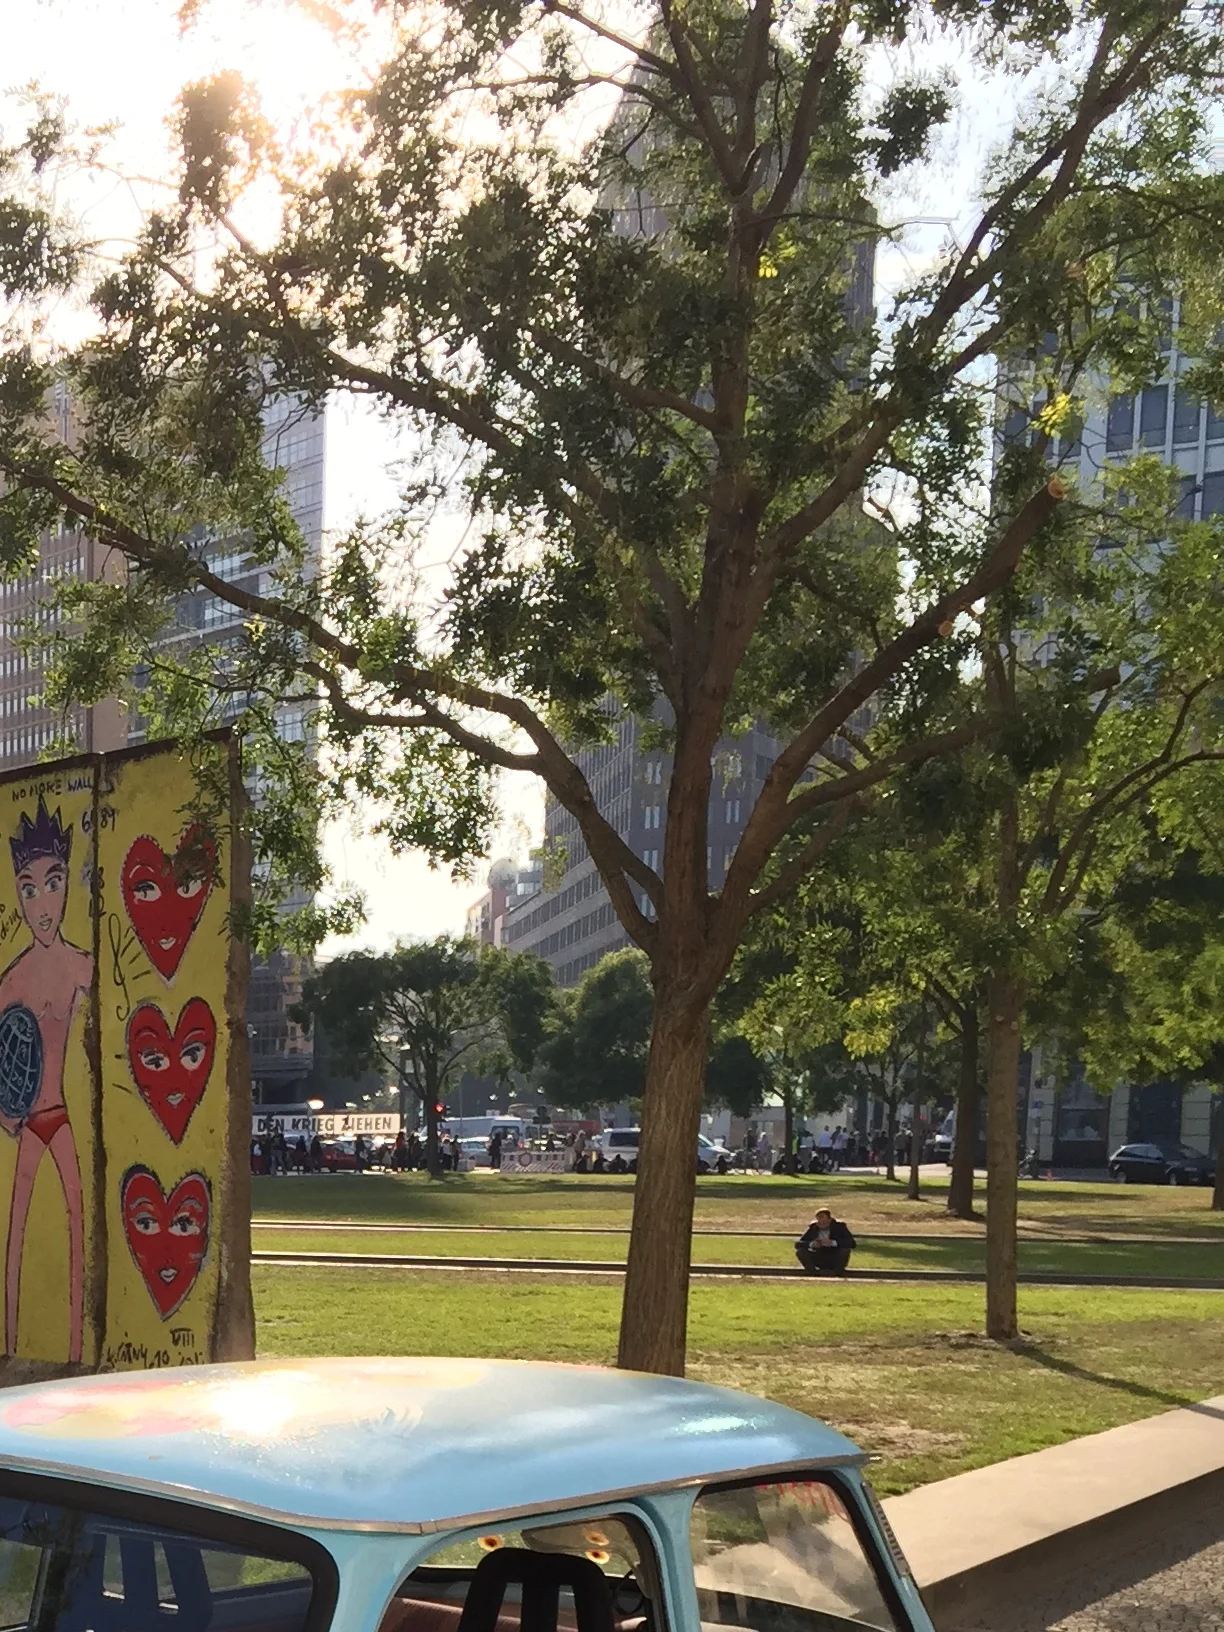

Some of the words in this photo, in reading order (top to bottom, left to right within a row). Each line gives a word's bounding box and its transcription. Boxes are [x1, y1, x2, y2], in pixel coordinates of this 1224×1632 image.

[12, 789, 26, 801] NO
[30, 779, 62, 797] MORE
[257, 1117, 284, 1132] DEN
[291, 1116, 334, 1133] KRIEG
[341, 1116, 392, 1132] ZIEHEN
